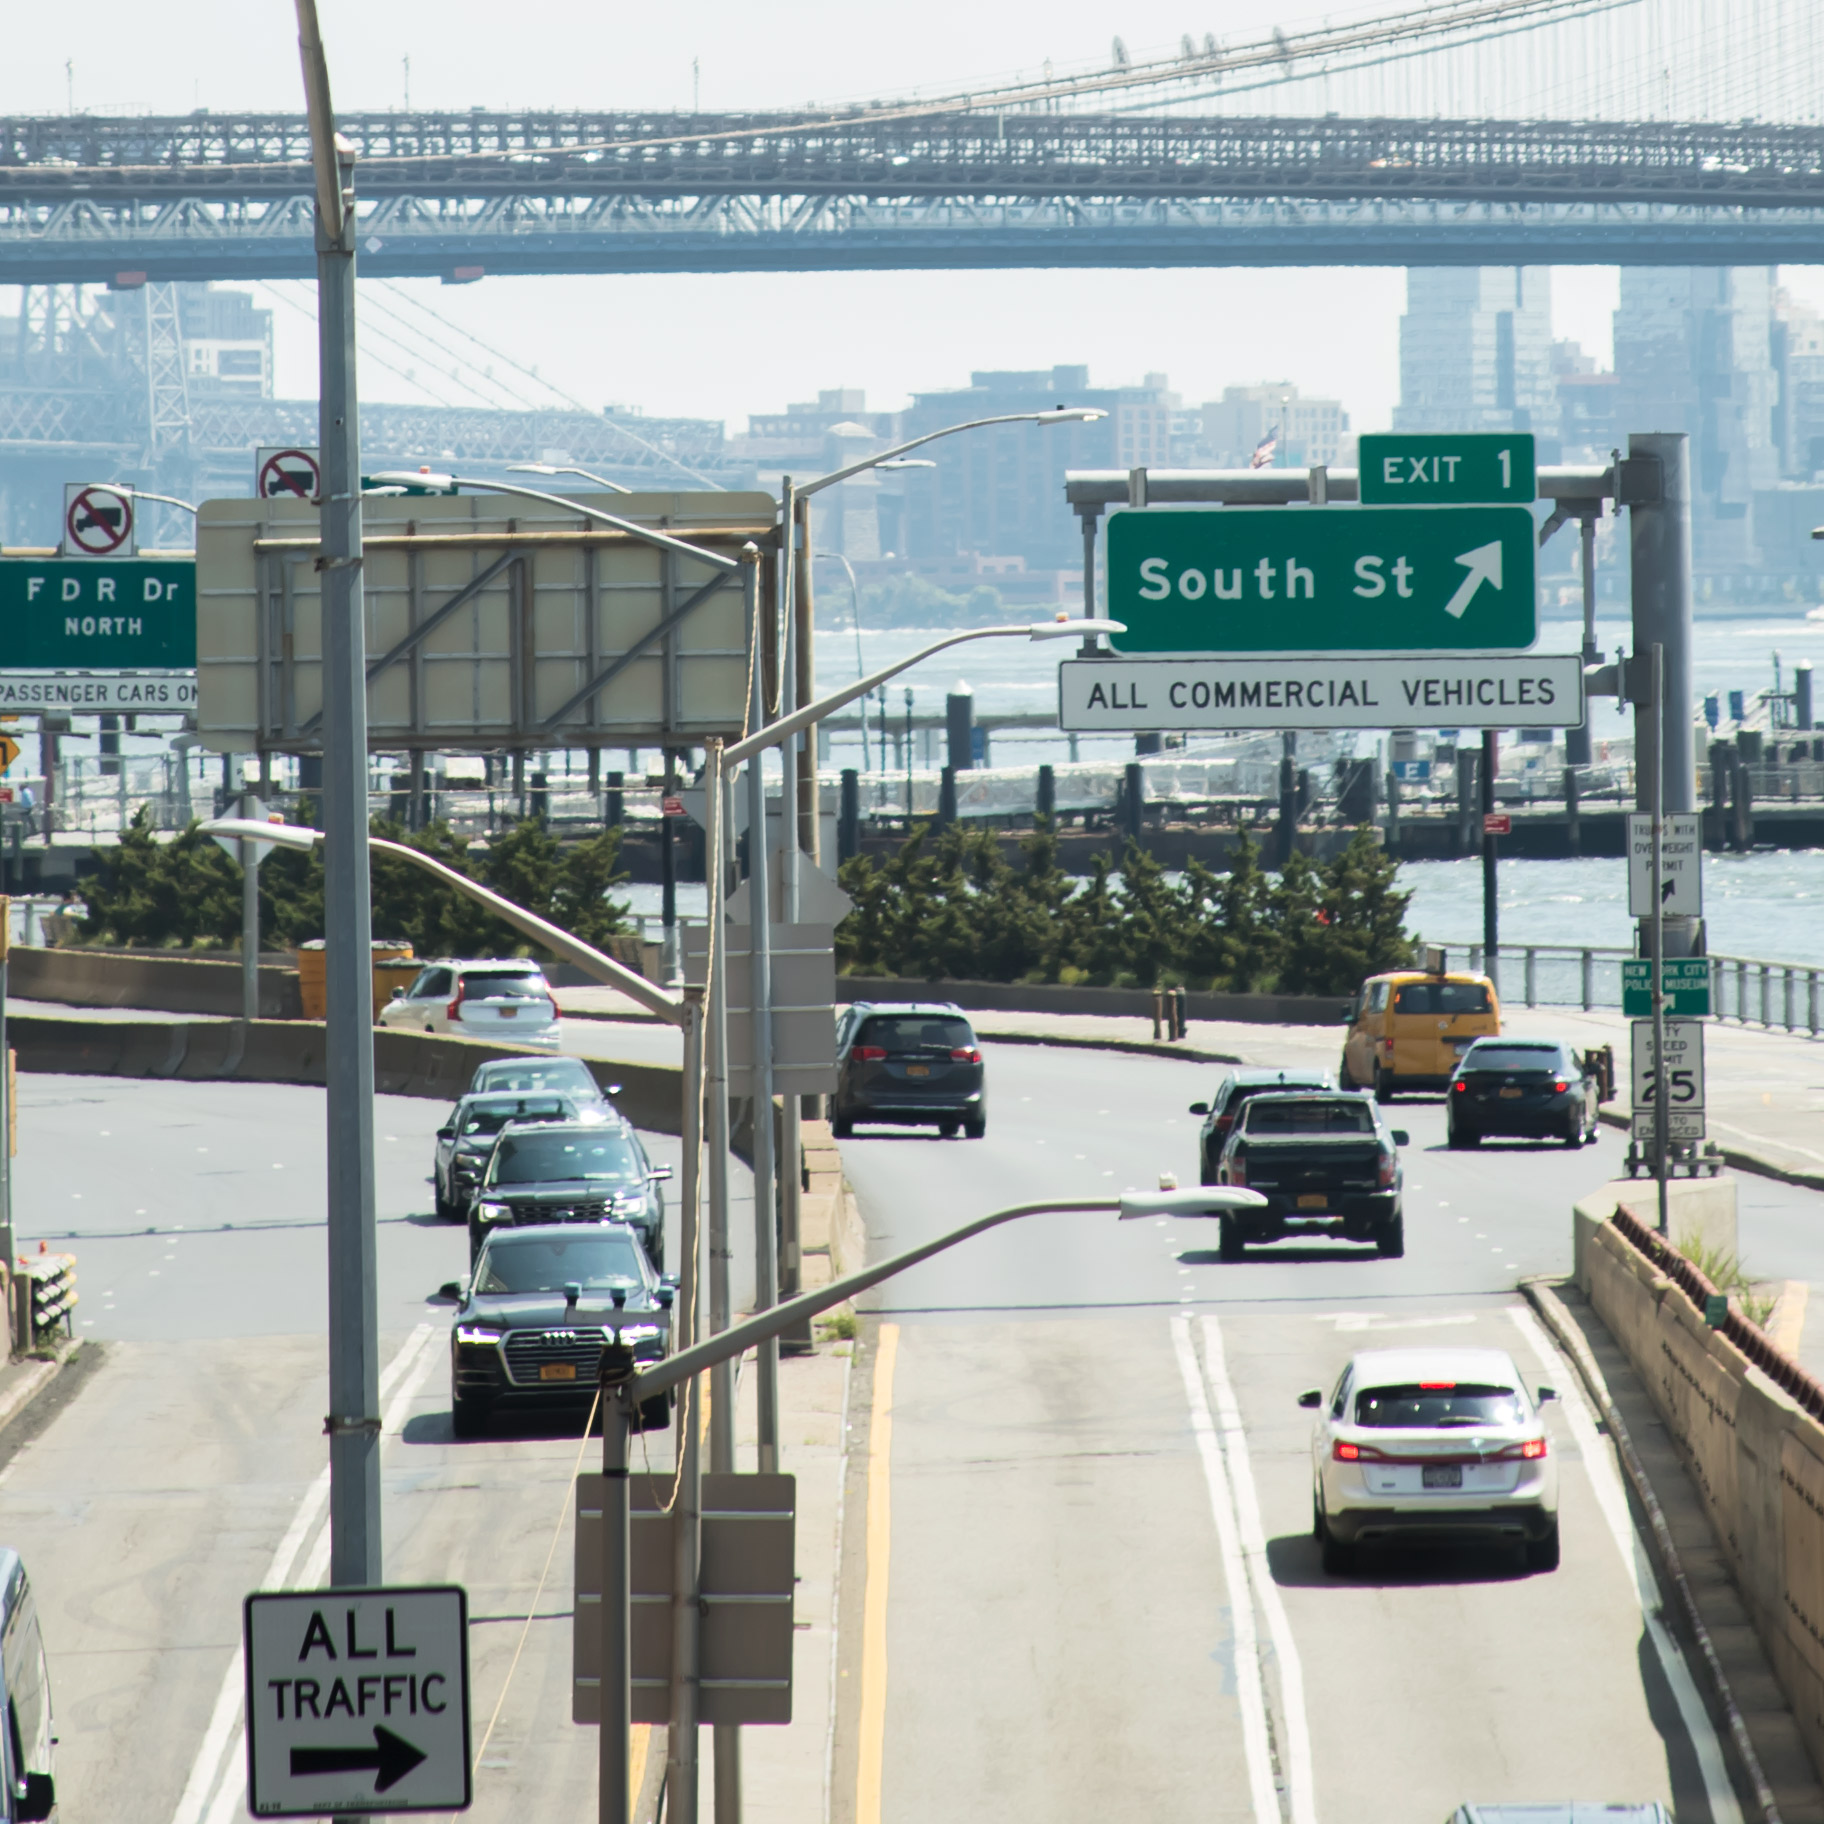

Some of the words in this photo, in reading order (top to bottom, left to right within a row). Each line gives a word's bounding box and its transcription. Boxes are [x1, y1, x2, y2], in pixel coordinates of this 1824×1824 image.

[1383, 456, 1461, 483] EXIT
[1498, 450, 1510, 488] 1
[1138, 556, 1314, 600] South
[1353, 555, 1414, 598] St
[143, 578, 178, 601] Dr
[65, 617, 142, 636] NORTH
[117, 684, 169, 702] CARS
[1087, 682, 1147, 708] ALL
[1169, 680, 1378, 708] COMMERCIAL
[1402, 678, 1555, 706] VEHICLES
[1674, 824, 1695, 835] WITH
[1634, 842, 1694, 854] OVEWEIGHT
[1625, 965, 1647, 976] NEW
[1683, 964, 1708, 976] CITY
[1664, 978, 1708, 990] MUSEUM
[1646, 1041, 1687, 1051] SEED
[1642, 1070, 1696, 1102] 25
[298, 1607, 417, 1662] ALL
[268, 1672, 447, 1720] TRAFFIC
